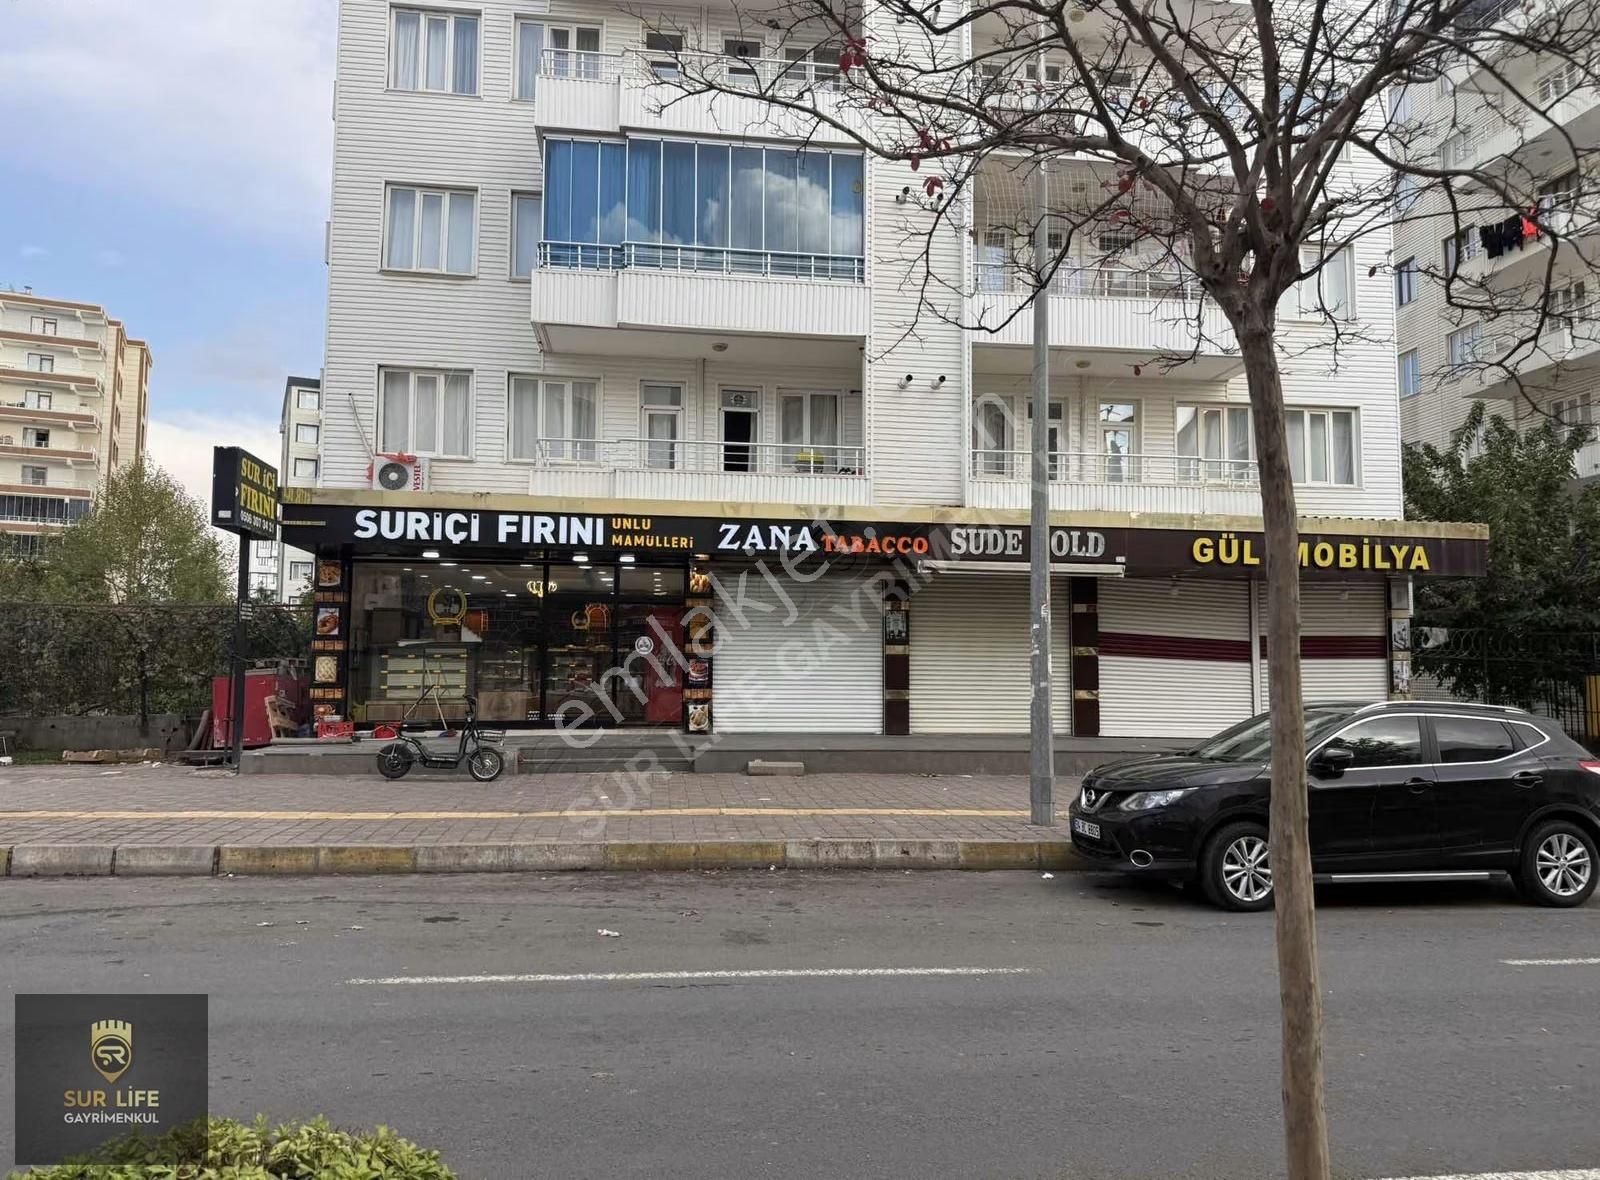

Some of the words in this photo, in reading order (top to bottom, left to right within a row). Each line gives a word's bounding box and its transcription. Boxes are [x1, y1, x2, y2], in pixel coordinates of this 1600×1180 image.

[241, 458, 260, 485] SUR
[413, 465, 421, 491] VESTEL
[240, 482, 275, 519] FIRINI
[498, 514, 604, 545] FIRINI
[612, 518, 651, 530] UNLU
[718, 523, 817, 551] ZANA
[821, 533, 929, 554] TABACCO
[951, 528, 1023, 555] SUDE
[1050, 530, 1106, 557] OLD
[1193, 533, 1260, 564] GÜL
